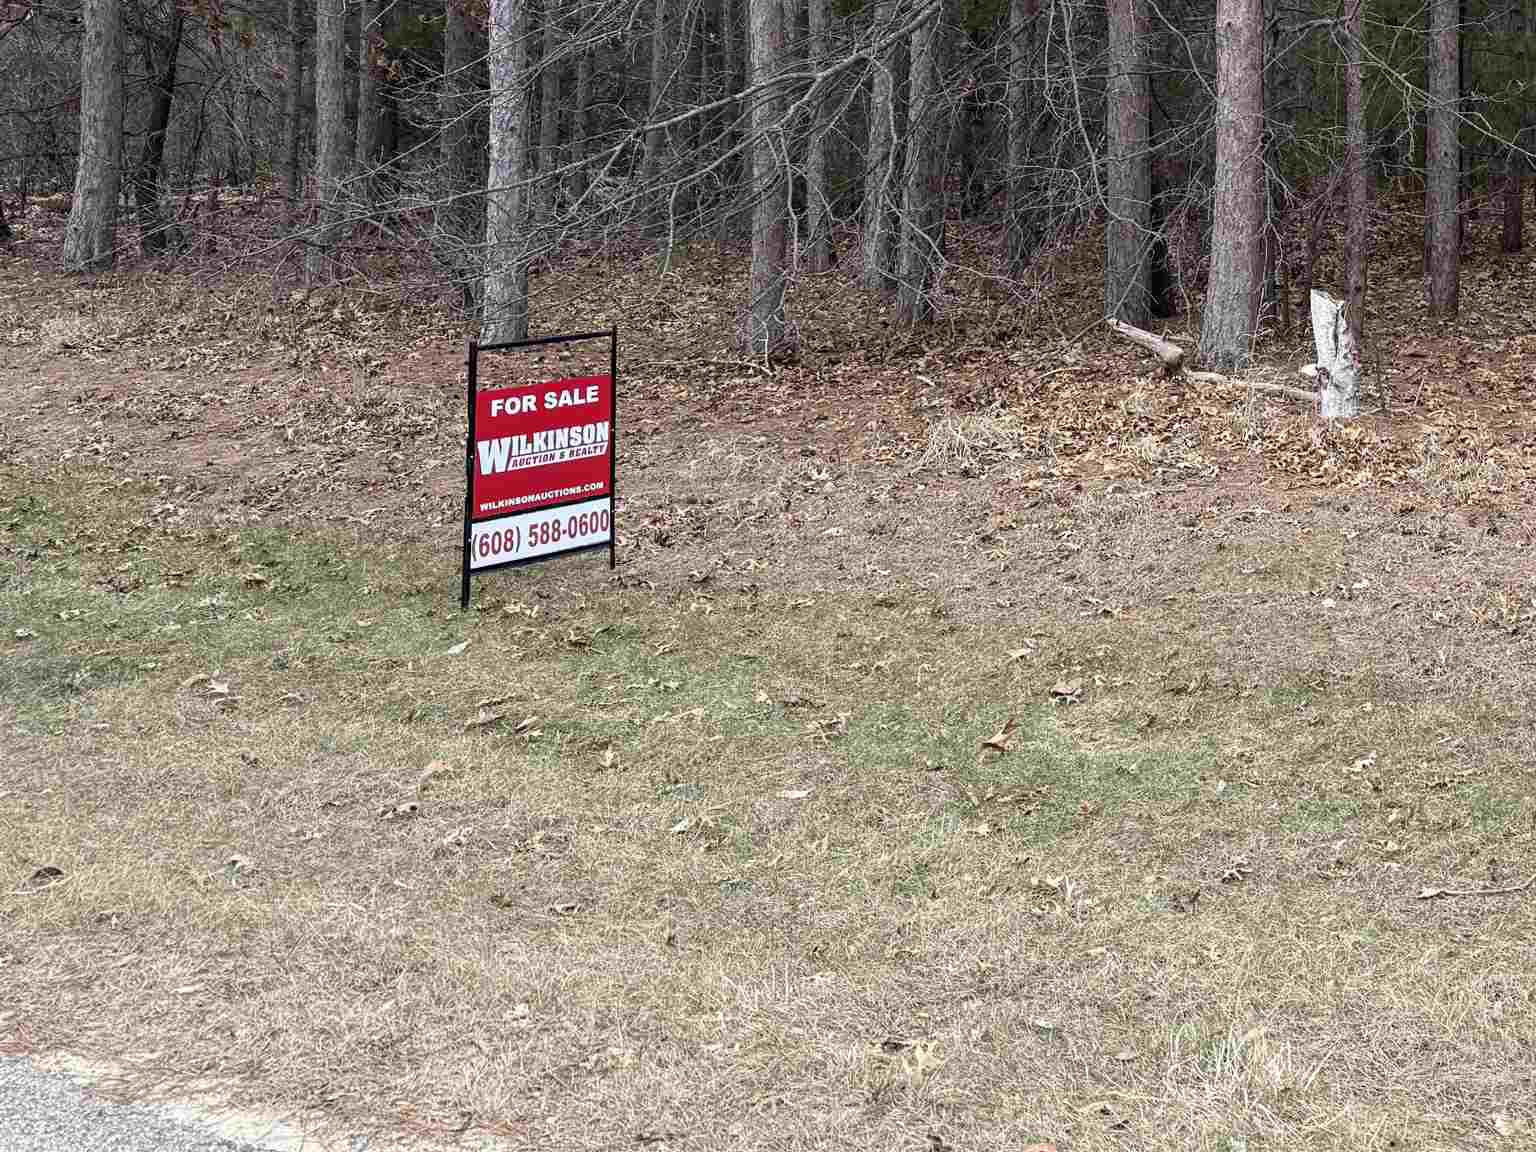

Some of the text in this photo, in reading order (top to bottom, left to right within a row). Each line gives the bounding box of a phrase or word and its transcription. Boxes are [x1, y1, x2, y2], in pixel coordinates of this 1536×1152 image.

[491, 385, 600, 417] FOR SALE
[477, 421, 609, 475] WILKINSON
[512, 452, 555, 468] AUCTION
[569, 444, 605, 459] REALTY
[479, 481, 604, 512] WILKINSONAUCTIONS.COM
[471, 509, 609, 562] (608) 588-0600
